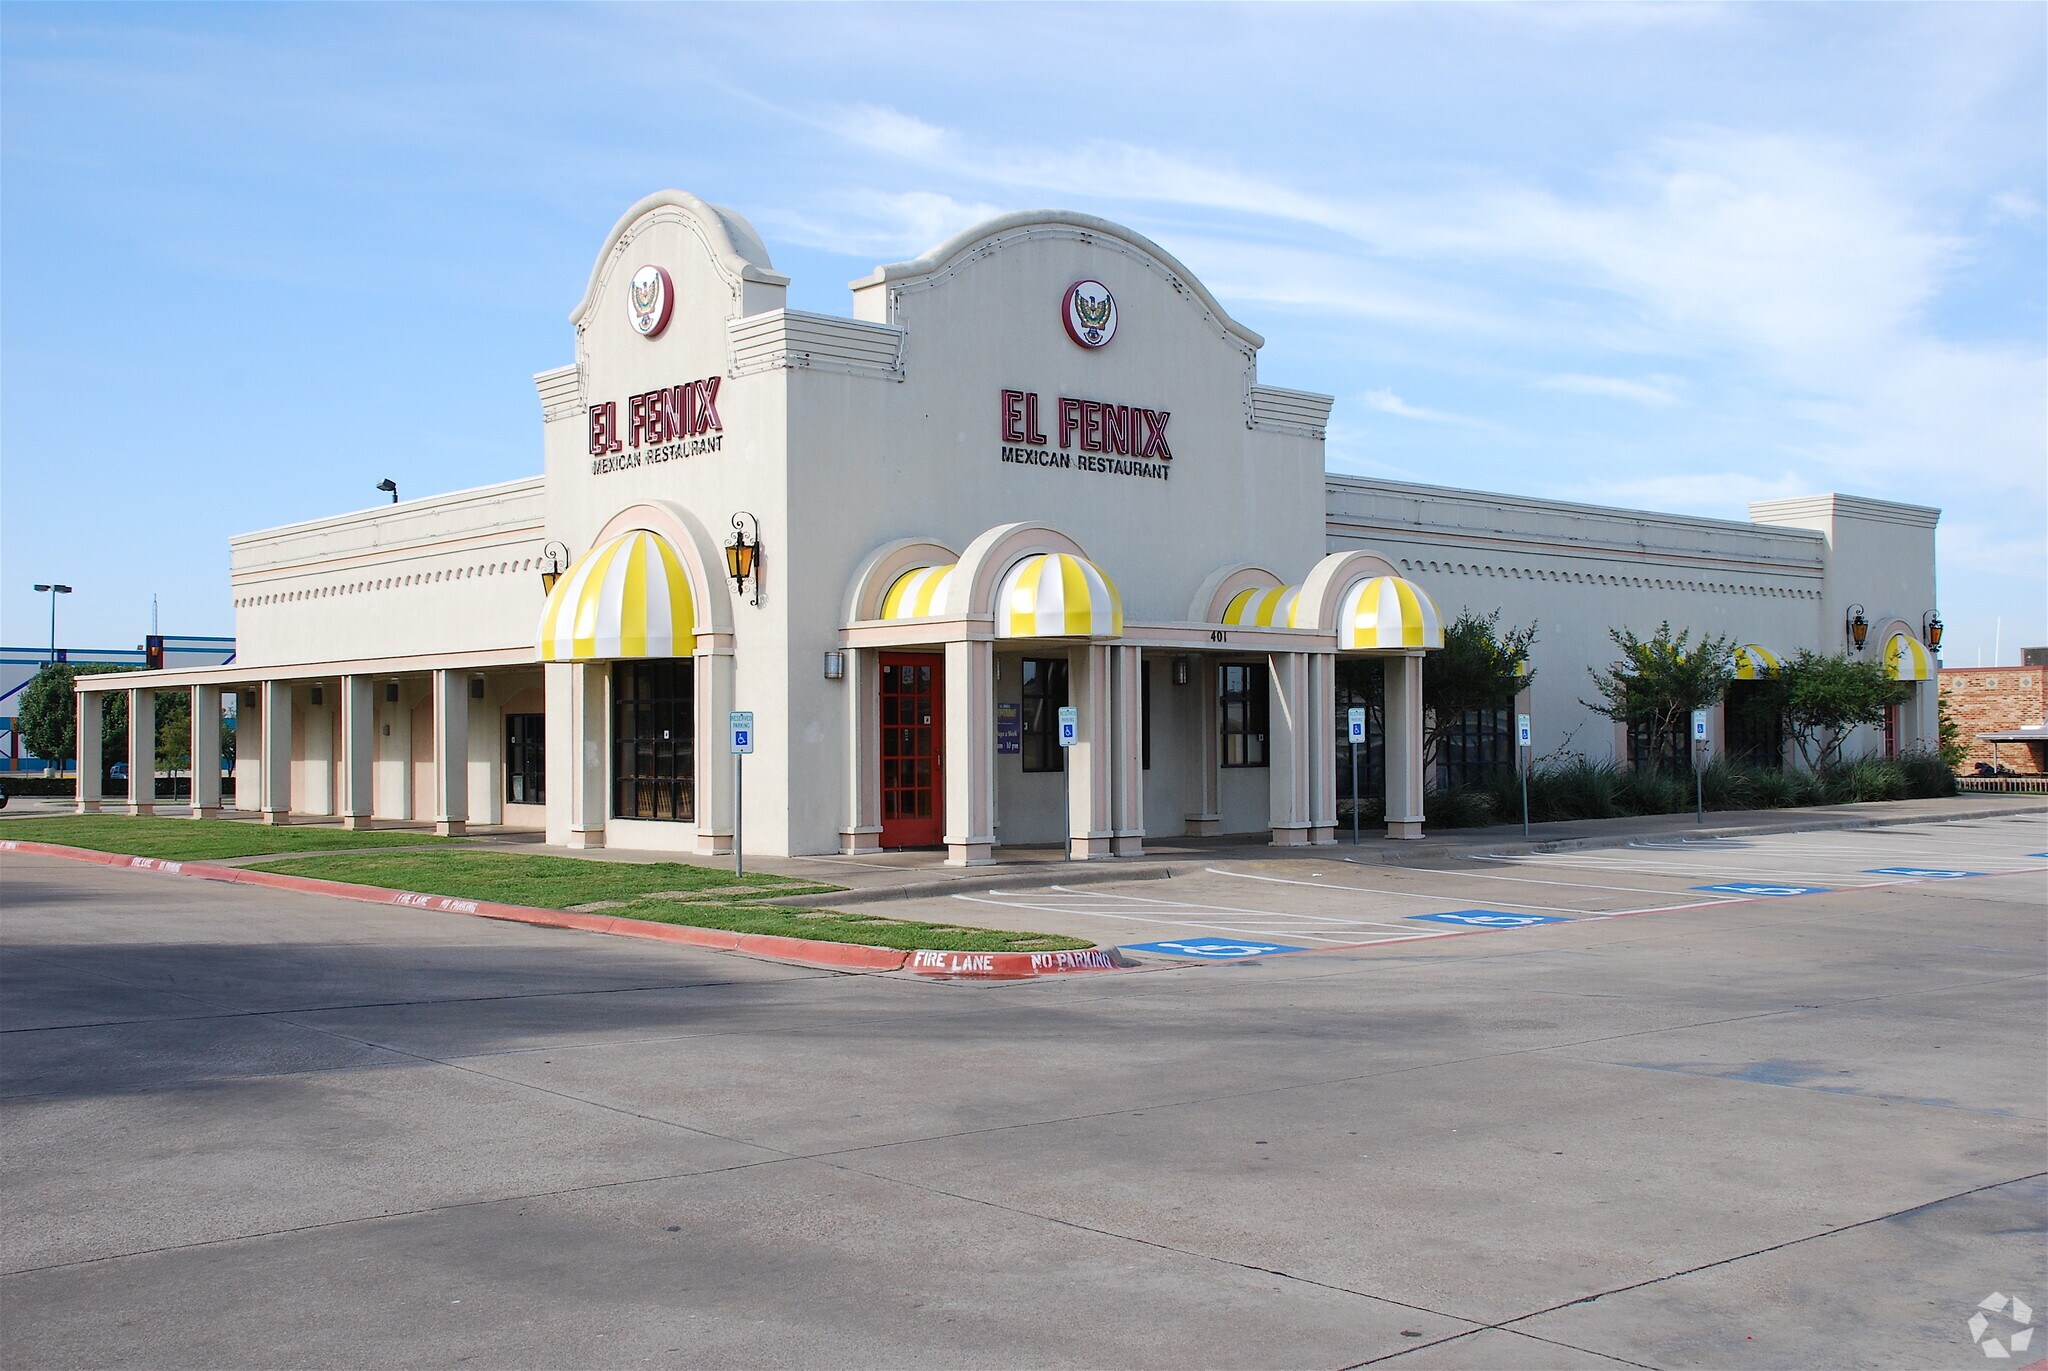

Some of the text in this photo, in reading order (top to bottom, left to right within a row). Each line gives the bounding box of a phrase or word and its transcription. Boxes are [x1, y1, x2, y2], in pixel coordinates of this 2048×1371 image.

[589, 376, 723, 456] EL FENIX
[1002, 389, 1173, 460] EL FENIX
[593, 435, 723, 475] MEXICAN RESTAURANT
[1002, 447, 1171, 480] MEXICAN RESTAURANT
[1211, 630, 1226, 643] 401
[411, 894, 432, 906] LANE
[450, 900, 478, 914] PARKING
[914, 950, 1111, 971] FIRE LANE NO PARKING
